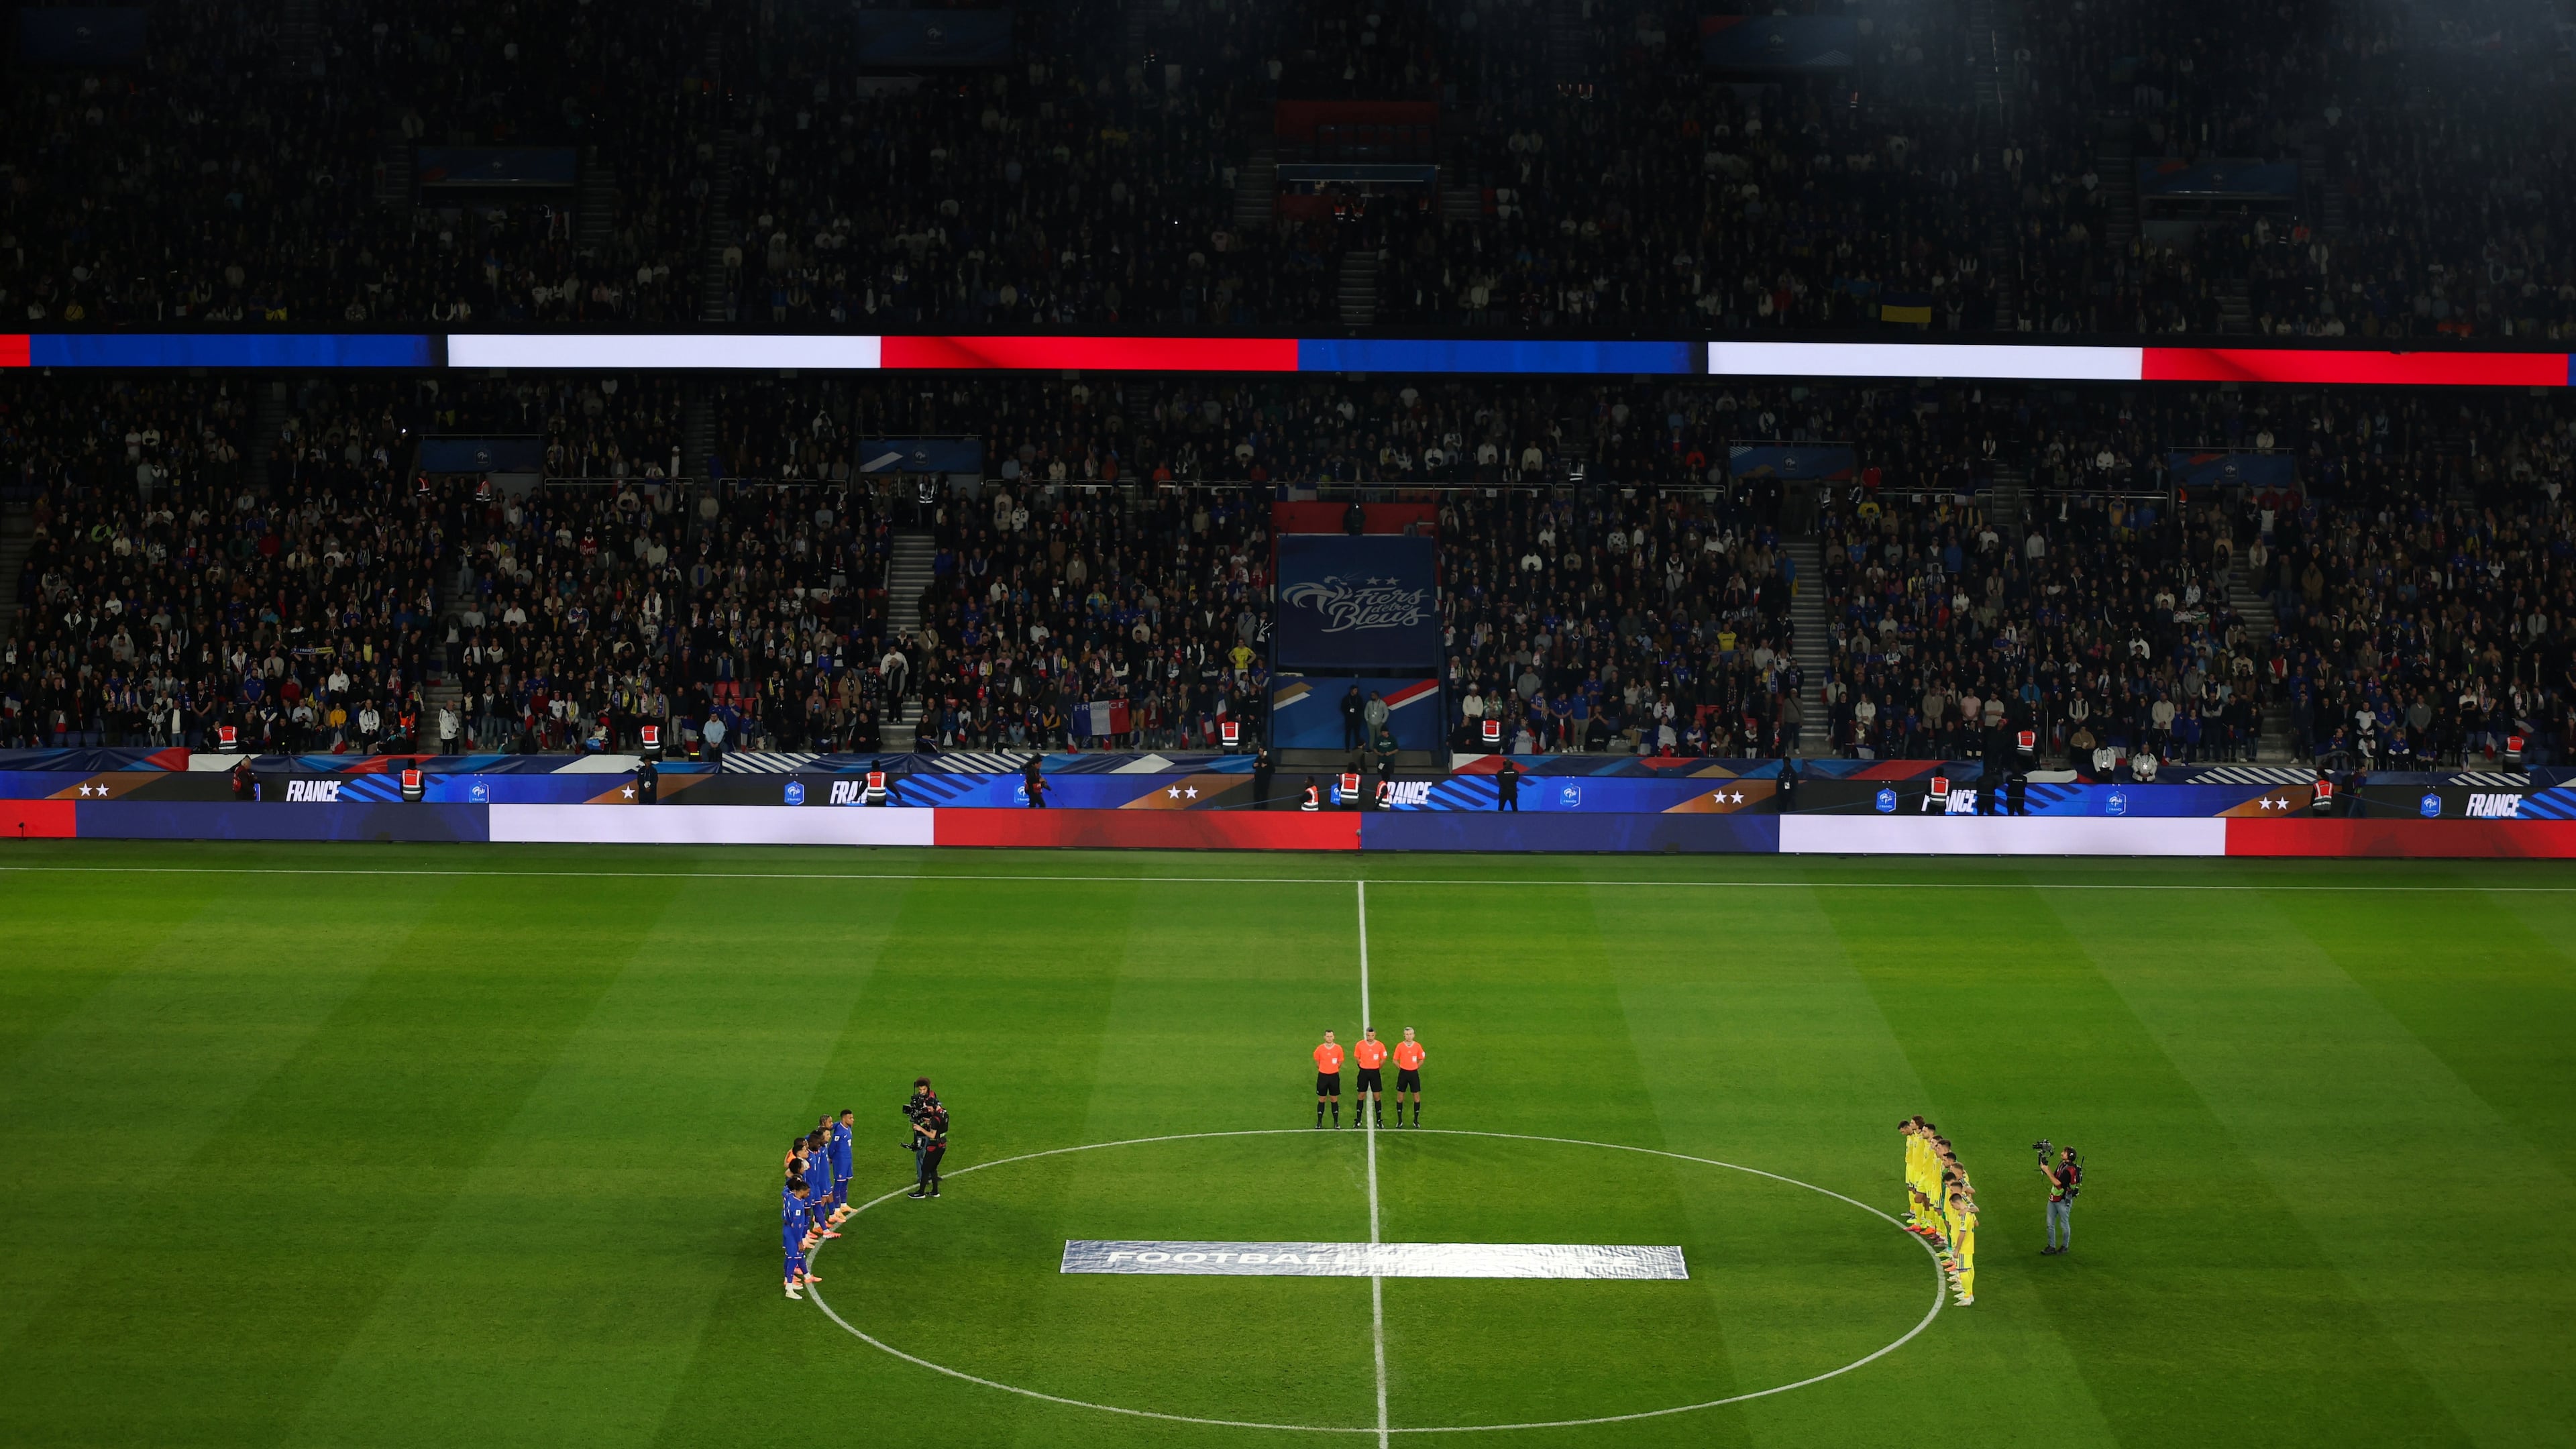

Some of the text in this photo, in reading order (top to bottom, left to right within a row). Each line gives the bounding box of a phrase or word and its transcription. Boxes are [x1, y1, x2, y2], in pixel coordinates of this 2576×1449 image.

[1354, 586, 1430, 605] Fiers
[1322, 602, 1431, 633] Bleus
[1075, 702, 1125, 711] FRANCE
[286, 780, 341, 802] FRANCE
[1387, 782, 1433, 804] RANCE
[2465, 794, 2522, 816] FRANCE
